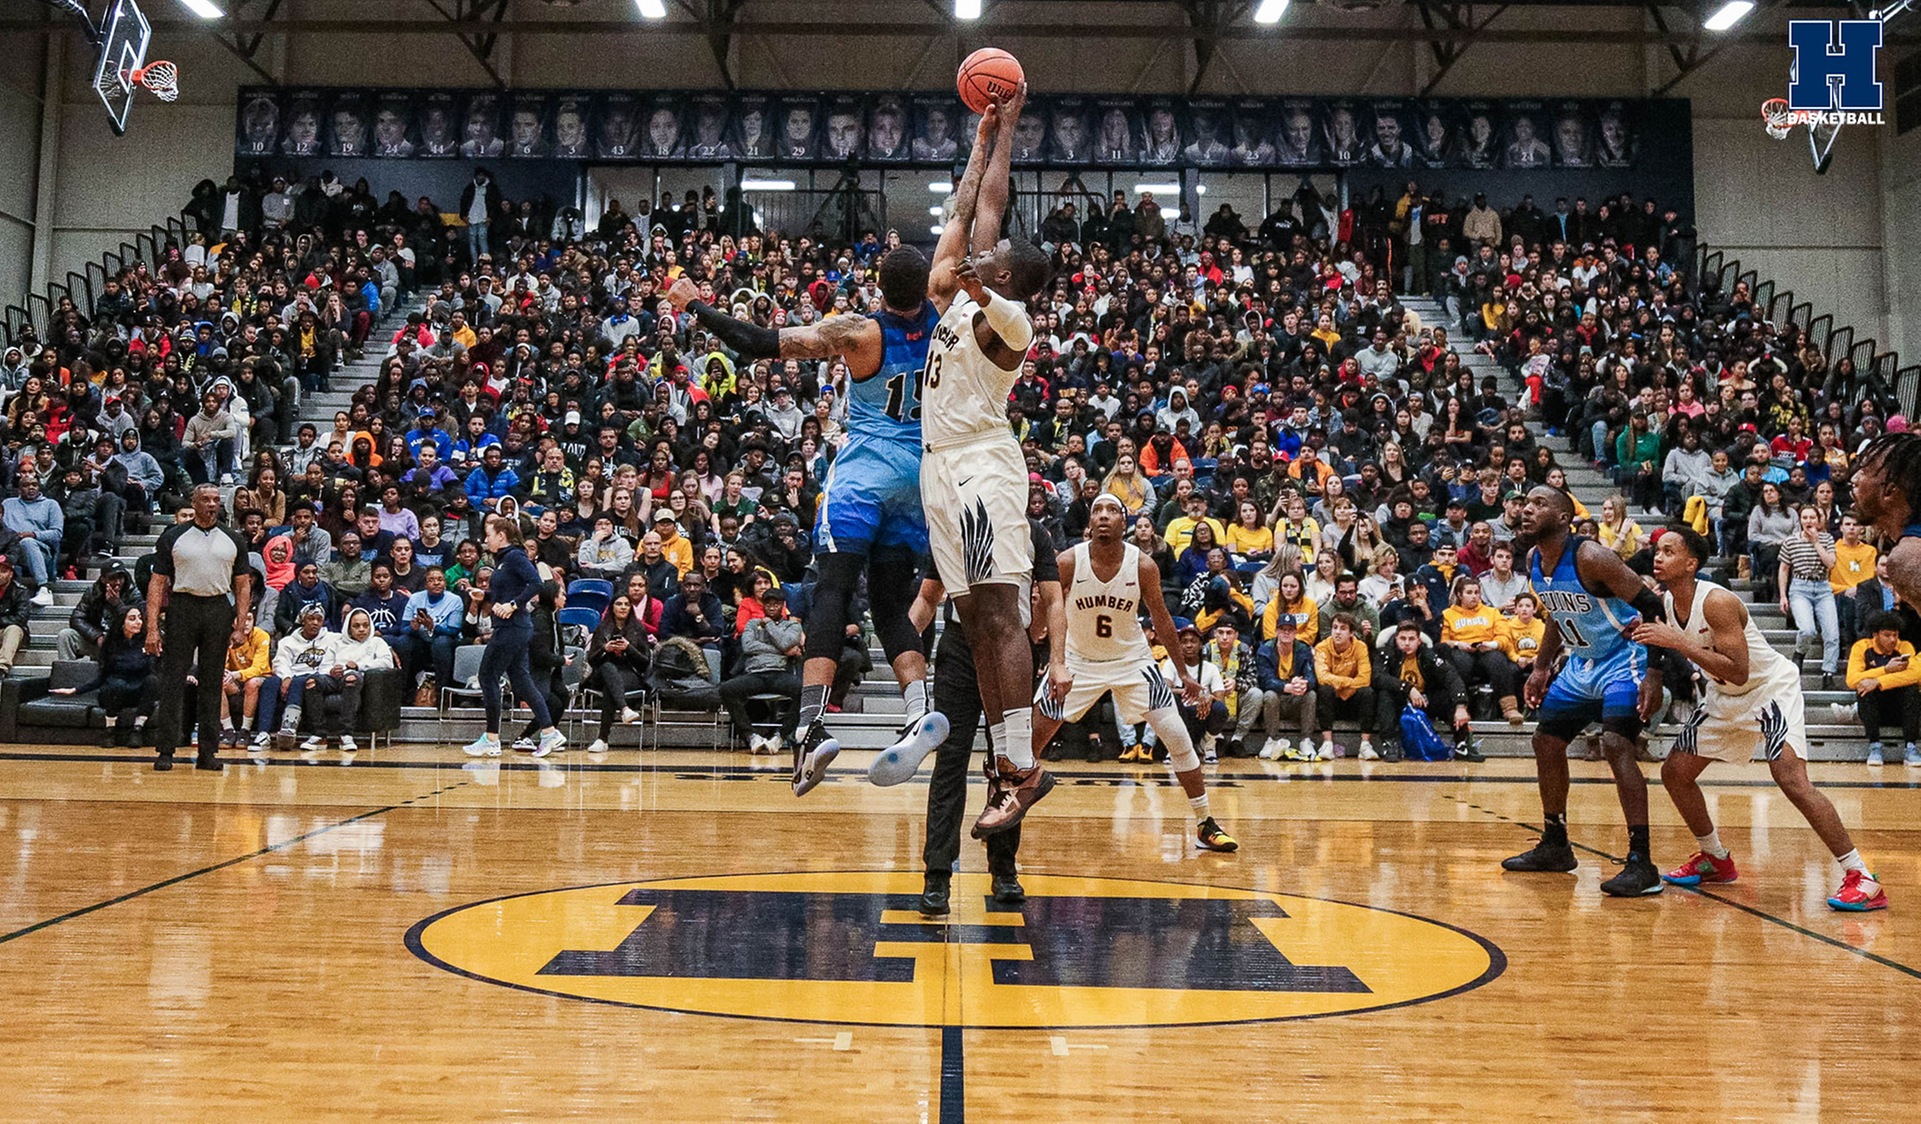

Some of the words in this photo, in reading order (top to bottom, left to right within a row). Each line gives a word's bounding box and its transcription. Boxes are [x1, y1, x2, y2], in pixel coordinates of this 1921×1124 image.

[252, 141, 264, 151] 10
[296, 142, 308, 152] 12
[342, 143, 354, 153] 19
[385, 144, 398, 154] 24
[611, 145, 624, 155] 43
[658, 146, 670, 156] 18
[702, 146, 715, 156] 22
[747, 146, 759, 156] 21
[792, 146, 805, 156] 29
[1112, 150, 1122, 160] 11
[1338, 150, 1351, 160] 10
[1075, 594, 1134, 613] HUMBER
[1096, 614, 1113, 638] 6
[1554, 617, 1590, 648] 11
